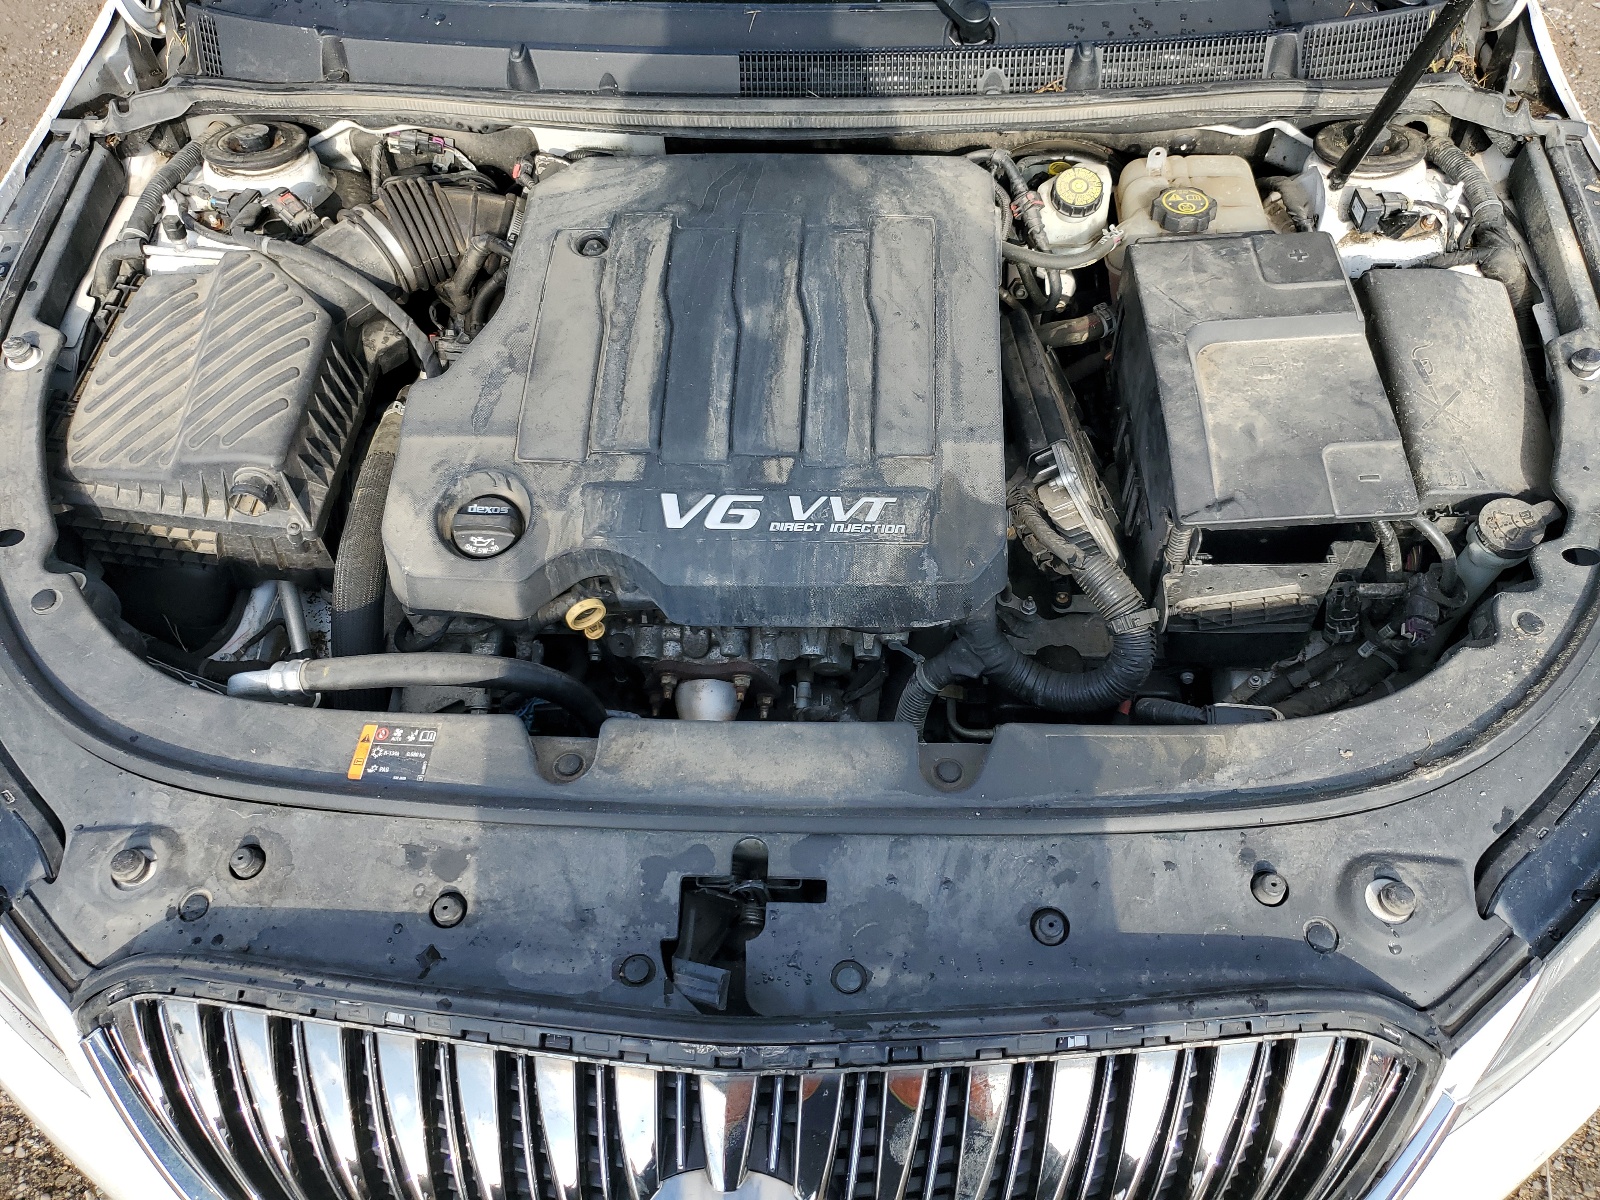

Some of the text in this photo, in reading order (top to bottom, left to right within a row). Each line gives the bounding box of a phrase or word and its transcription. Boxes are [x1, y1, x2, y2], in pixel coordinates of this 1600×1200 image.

[468, 504, 509, 514] dexos
[660, 493, 898, 530] V6 VVT
[769, 522, 906, 534] DIRECT INJECTION
[464, 543, 499, 554] SAE 5W-30
